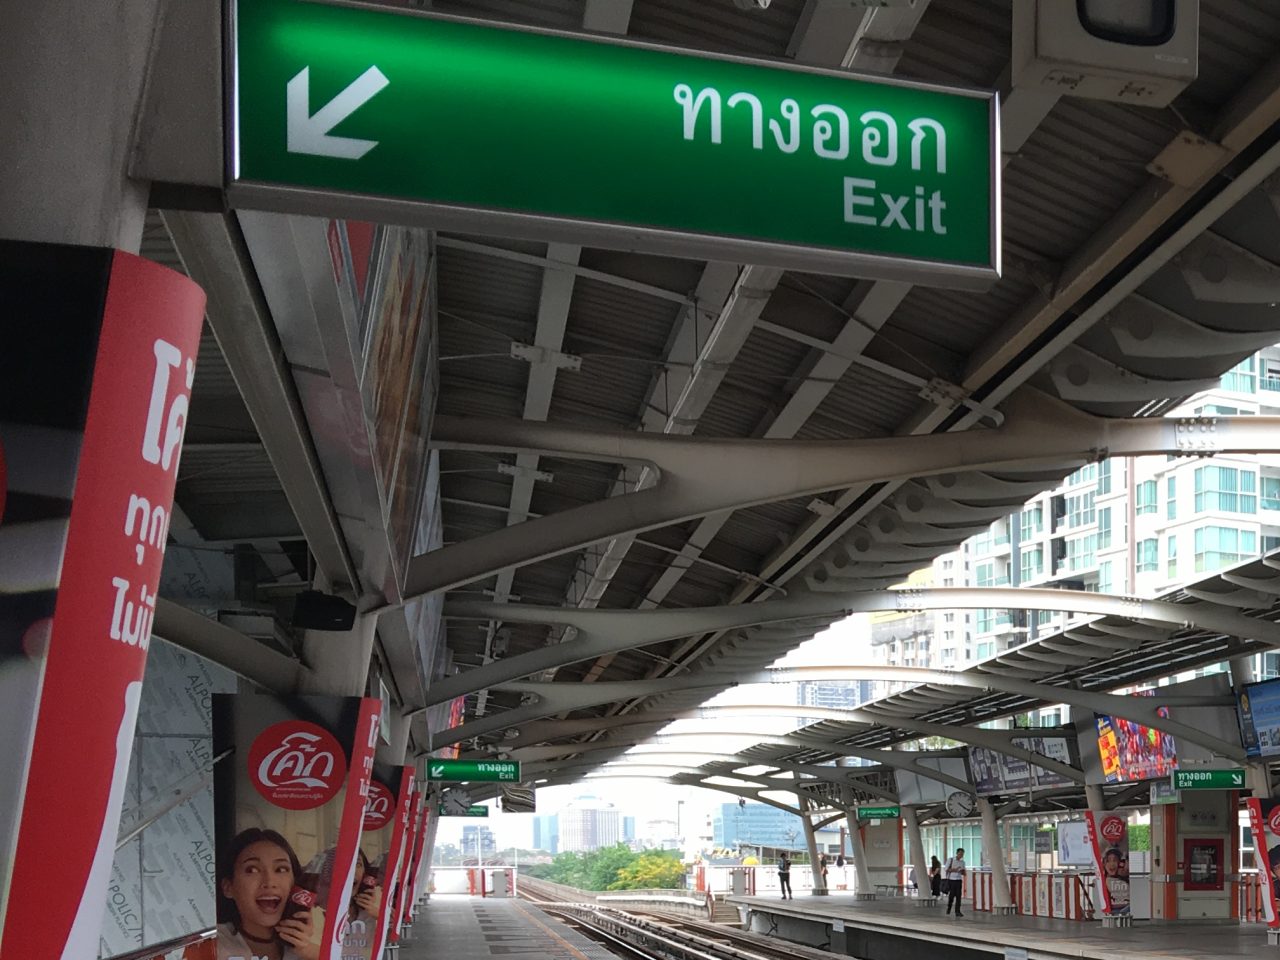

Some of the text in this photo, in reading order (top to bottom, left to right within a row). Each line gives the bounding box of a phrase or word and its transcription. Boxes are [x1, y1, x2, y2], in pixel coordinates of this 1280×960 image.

[673, 83, 948, 174] ทางออก
[843, 176, 948, 235] Exit
[257, 731, 335, 788] โค้ก
[477, 762, 515, 773] ทางออก
[498, 772, 515, 781] Exit
[1177, 772, 1212, 781] ทางออก
[1179, 780, 1193, 788] Exit
